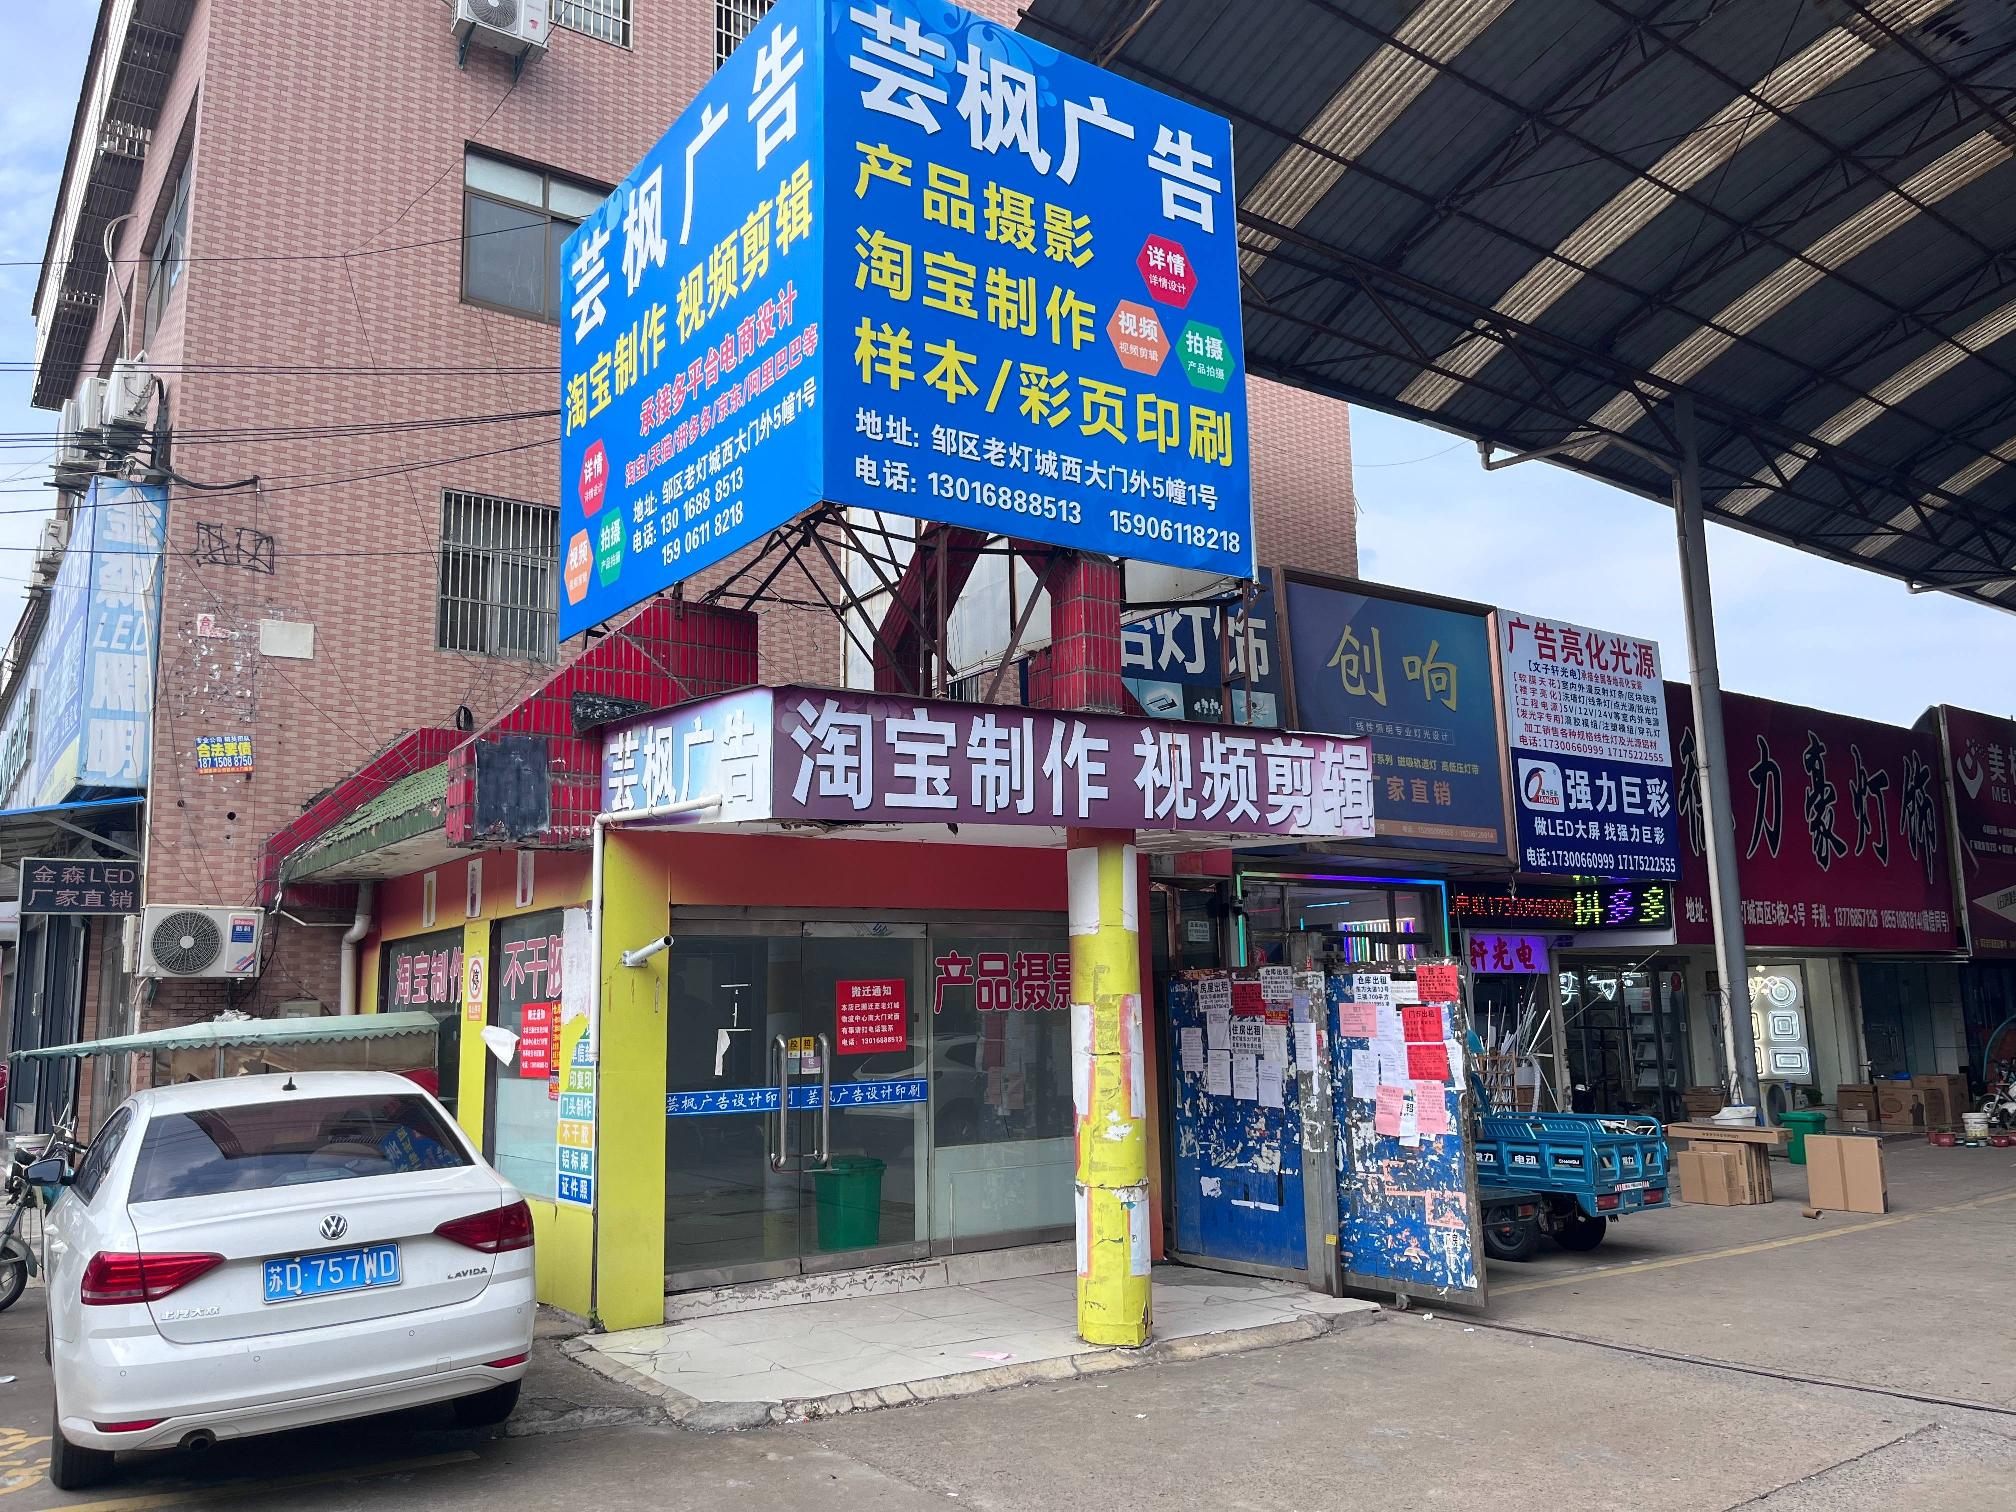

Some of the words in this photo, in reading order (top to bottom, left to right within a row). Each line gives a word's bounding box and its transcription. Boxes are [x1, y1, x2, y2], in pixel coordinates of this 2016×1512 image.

[849, 3, 1222, 234] 芸枫广告
[571, 22, 804, 346] 芸枫广告
[854, 140, 1094, 269] 产品摄影
[1147, 245, 1185, 278] 详情
[565, 302, 667, 436] 淘宝制作
[676, 160, 813, 345] 视频剪辑
[854, 225, 1096, 351] 淘宝制作
[1149, 274, 1186, 295] 详情设计
[1118, 310, 1158, 342] 视频
[640, 280, 797, 436] 承接多平台电商设计
[1119, 341, 1158, 362] 视频剪辑
[1186, 331, 1223, 361] 拍摄
[1188, 361, 1225, 381] 产品拍摄
[624, 323, 818, 488] 淘宝/天猫/拼多多/京东/阿里巴巴等
[853, 317, 1233, 467] 样本/彩页印刷
[662, 376, 817, 506] 邹区老灯城西大门外5幢1号
[584, 452, 603, 483] 详情
[931, 424, 1218, 512] 邹区老灯城西大门外5幢1号
[660, 508, 679, 537] 130
[683, 488, 711, 524] 1688
[714, 466, 744, 502] 8513
[928, 472, 1082, 525] 13016888513
[1109, 509, 1241, 554] 15906118218
[600, 517, 622, 553] 拍摄
[661, 537, 681, 567] 159
[684, 518, 711, 554] 0611
[714, 500, 744, 537] 8218
[569, 540, 588, 571] 视频
[1508, 616, 1656, 680] 广告亮化光源
[1326, 624, 1457, 713] 创响
[198, 757, 211, 768] 187
[214, 757, 232, 768] 1508
[233, 755, 252, 767] 8750
[609, 709, 759, 812] 芸枫广告
[791, 698, 1109, 819] 淘宝制作
[1608, 747, 1664, 763] 17175222555
[1133, 726, 1374, 831] 视频剪辑
[1373, 775, 1451, 806] 家直销
[1565, 769, 1671, 818] 强力巨彩
[1534, 816, 1600, 840] 做LED大屏
[1604, 822, 1665, 845] 找强力巨彩
[32, 865, 135, 883] 金森LED
[1618, 854, 1676, 873] 17175222555
[28, 889, 134, 908] 厂家直销
[851, 985, 892, 998] 搬迁通知
[1200, 981, 1229, 994] 房屋出租
[1357, 975, 1387, 985] 仓库出租
[1231, 1024, 1261, 1036] 住房出租
[561, 1094, 592, 1119] 门头制作
[807, 1083, 921, 1106] 芸广告设计印刷
[562, 1123, 589, 1144] 不干胶
[561, 1146, 589, 1172] 铝标牌
[1514, 1155, 1537, 1165] 电动
[561, 1176, 588, 1200] 证件照
[447, 1266, 488, 1279] LAVIDA
